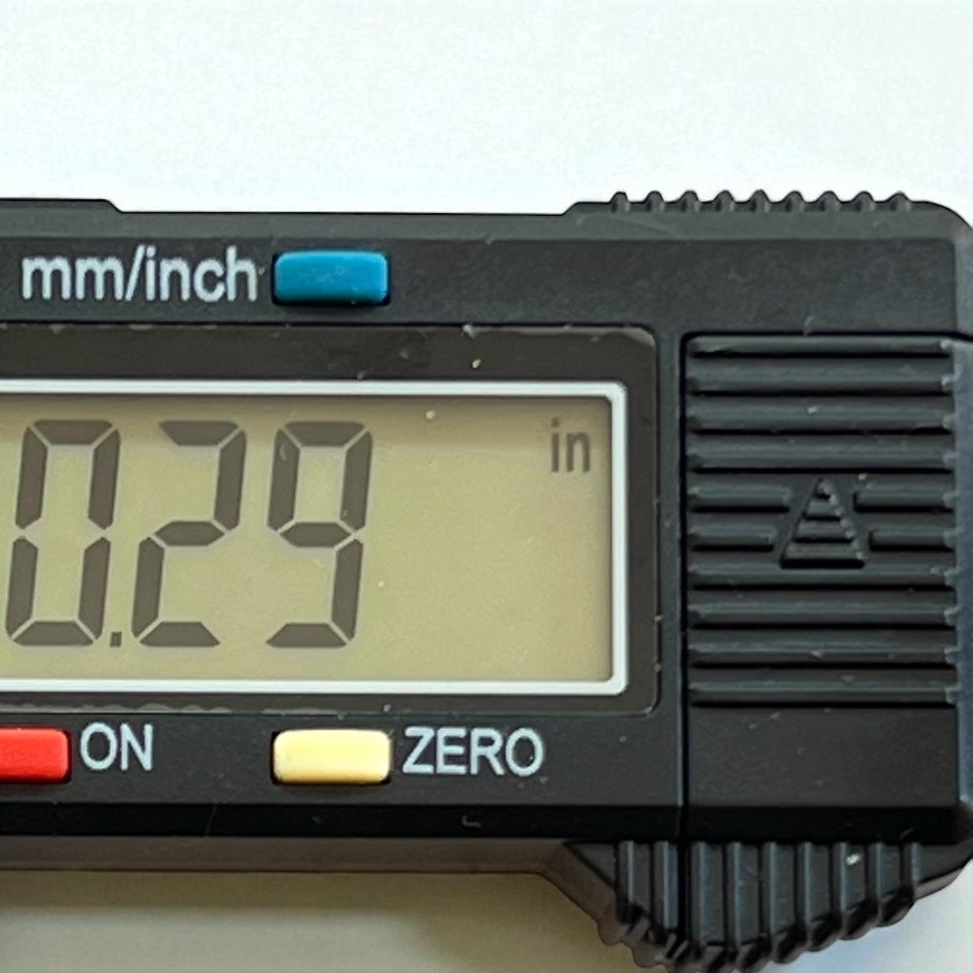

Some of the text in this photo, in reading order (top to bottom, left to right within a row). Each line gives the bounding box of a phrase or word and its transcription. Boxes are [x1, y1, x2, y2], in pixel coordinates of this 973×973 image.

[21, 245, 258, 303] mm/inch
[550, 419, 592, 473] in
[5, 419, 373, 649] 0.29
[80, 723, 154, 772] ON
[402, 726, 545, 777] ZERO
